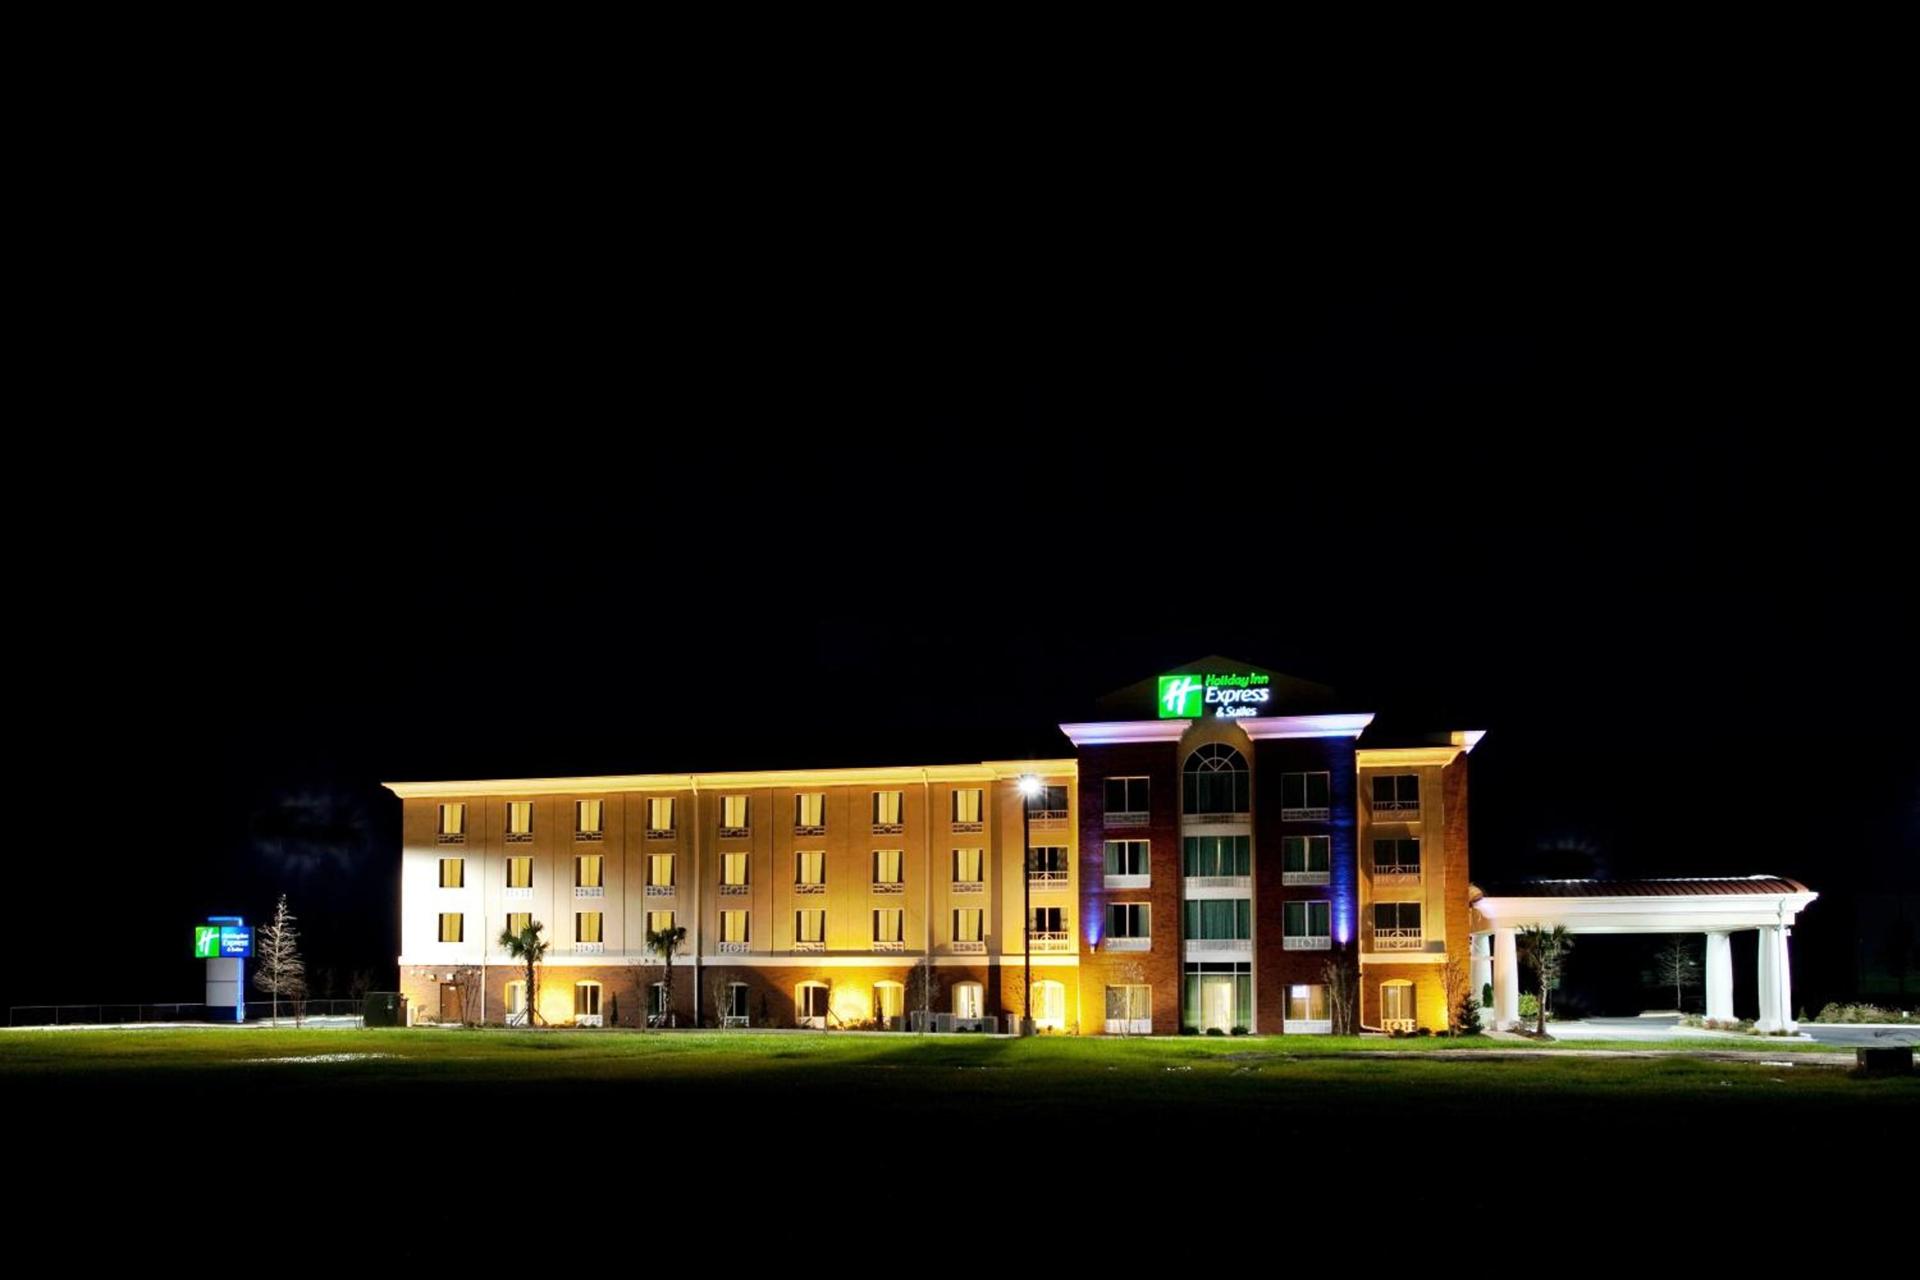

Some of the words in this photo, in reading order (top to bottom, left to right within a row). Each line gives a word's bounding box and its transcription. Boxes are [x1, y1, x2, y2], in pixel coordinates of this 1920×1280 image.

[1205, 674, 1248, 687] Holiday
[1250, 672, 1269, 684] Inn
[1205, 687, 1269, 706] Express
[1226, 706, 1257, 717] Suites
